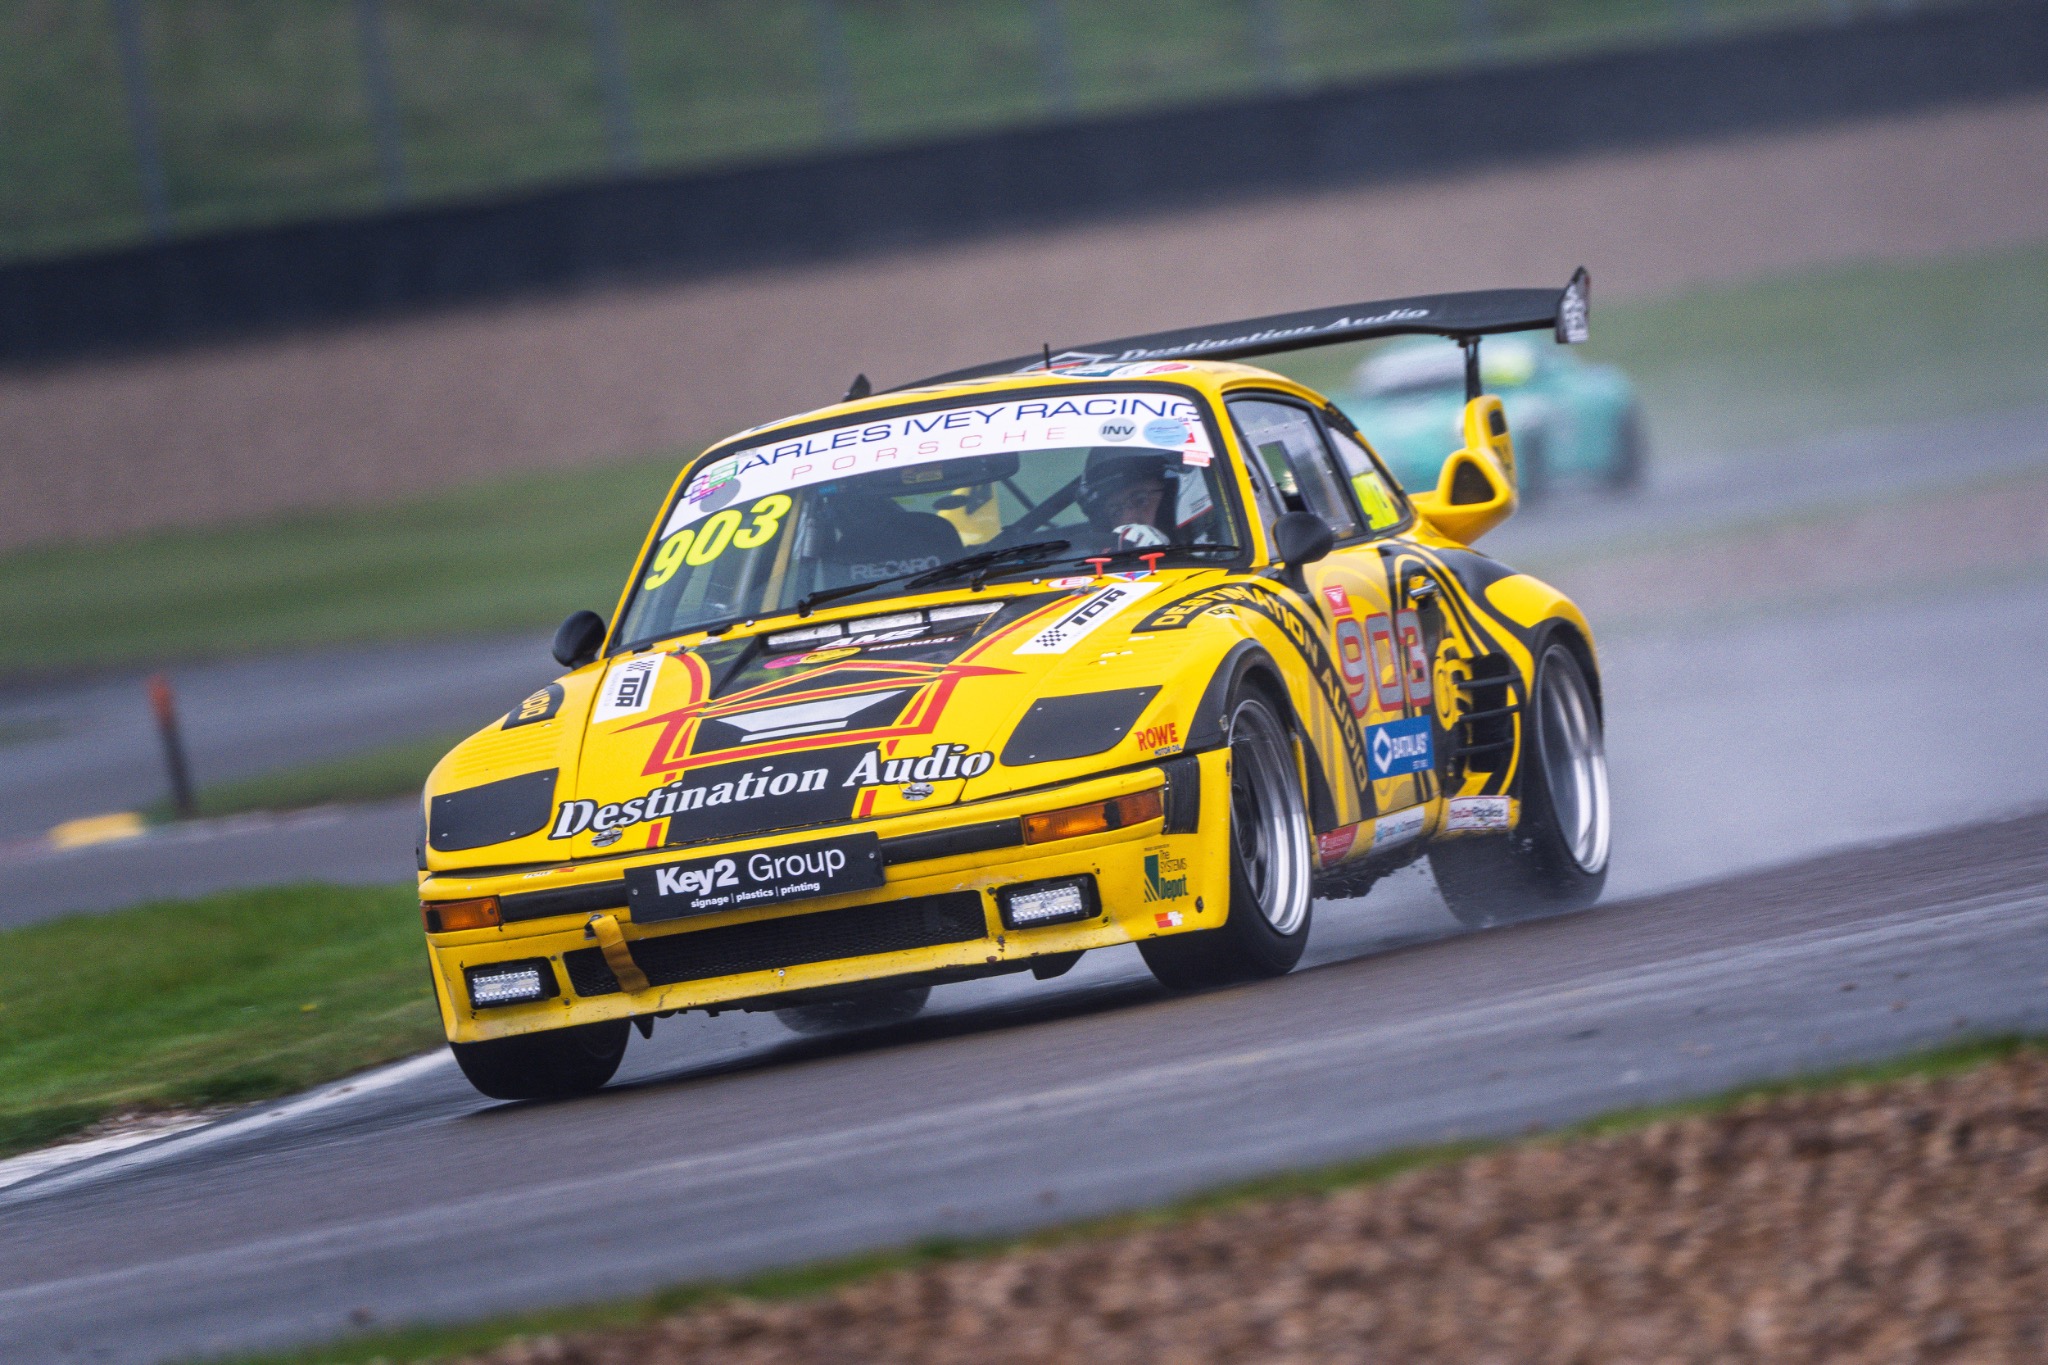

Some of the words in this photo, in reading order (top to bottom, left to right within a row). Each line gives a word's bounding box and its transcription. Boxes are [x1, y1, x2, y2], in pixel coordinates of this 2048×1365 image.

[1115, 326, 1313, 363] Destination
[1326, 308, 1431, 331] Audio
[903, 407, 1006, 436] IVEY
[1102, 425, 1136, 435] INV
[790, 426, 1066, 480] PORSCHE
[644, 494, 793, 591] 903
[1336, 607, 1434, 720] 903
[518, 689, 551, 720] UDIO
[1151, 585, 1320, 669] DESTINATION
[1320, 667, 1369, 793] AUDIO
[1134, 722, 1178, 751] ROWE
[548, 766, 829, 840] Destination
[842, 743, 994, 789] Audio
[655, 858, 739, 897] Key2
[748, 847, 846, 882] Group
[690, 895, 729, 909] signage
[736, 888, 774, 902] plastics
[780, 880, 821, 896] printing
[1160, 873, 1189, 902] Depot
